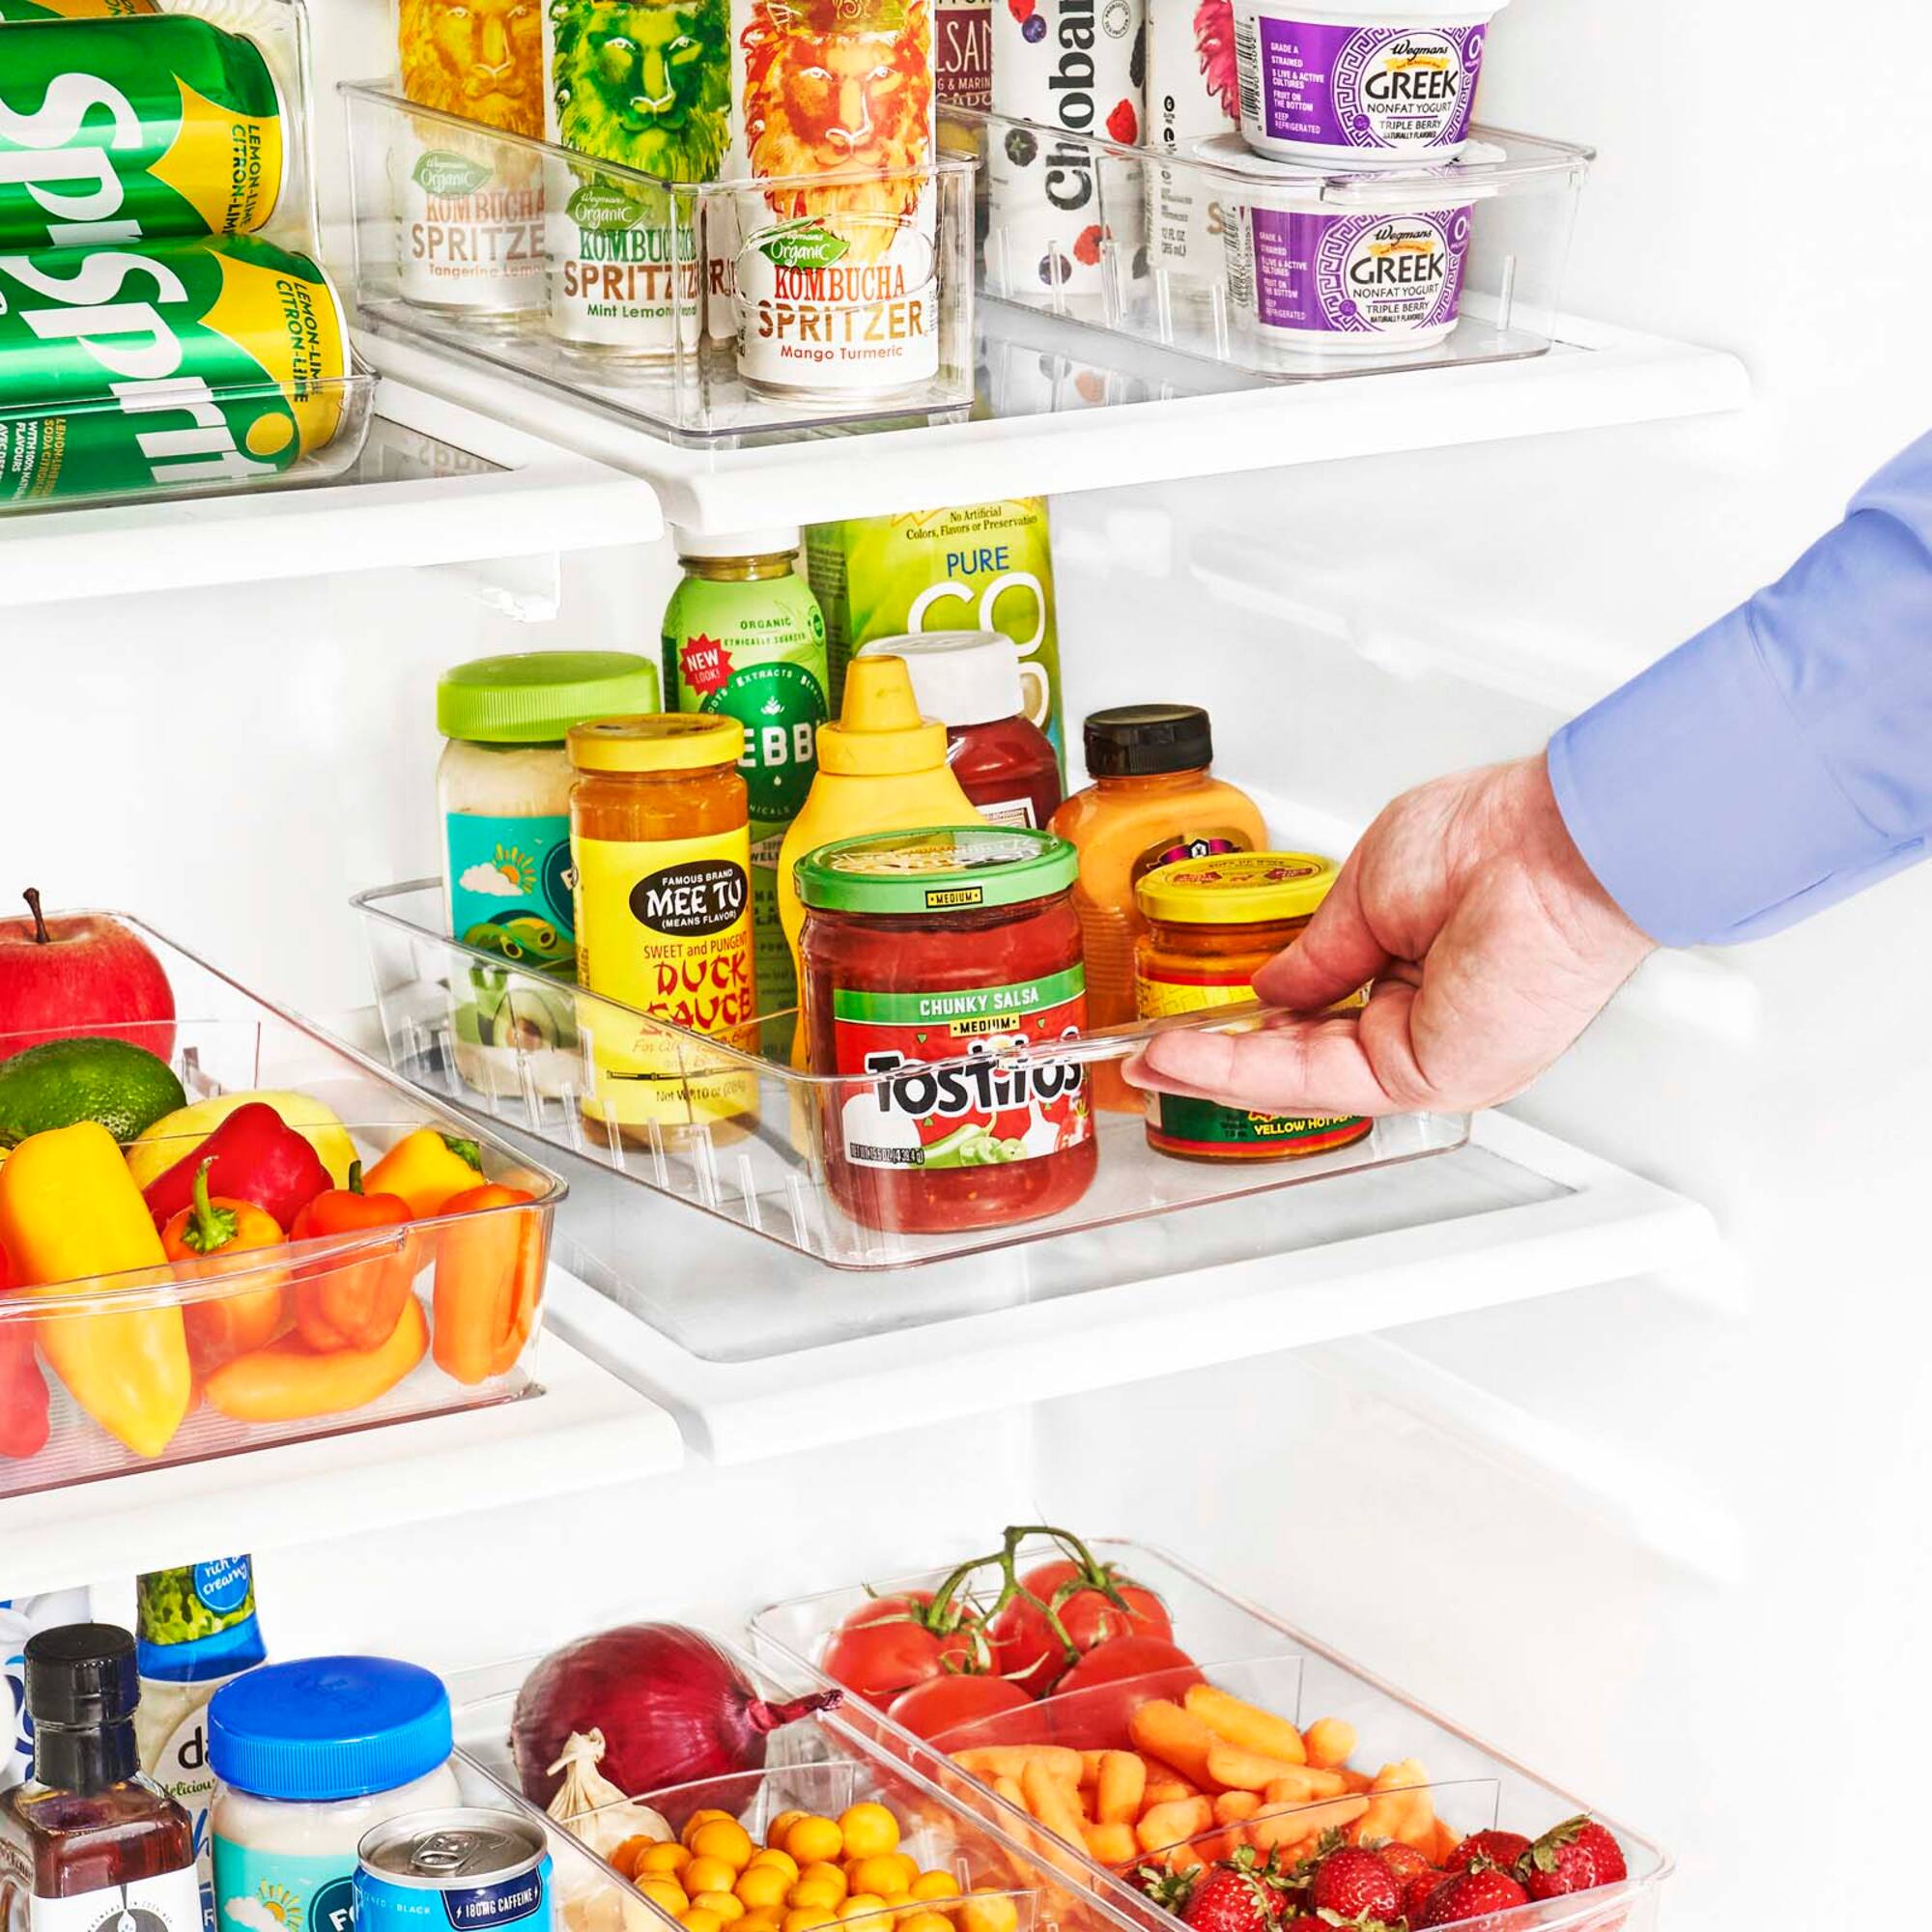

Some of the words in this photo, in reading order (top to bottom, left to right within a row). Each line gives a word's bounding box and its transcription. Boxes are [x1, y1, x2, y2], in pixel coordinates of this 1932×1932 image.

[1293, 45, 1299, 54] A
[1389, 40, 1449, 62] Wegmans
[1271, 55, 1303, 68] STRAINED
[1272, 77, 1305, 89] CULTURES
[1277, 69, 1291, 79] LIVE
[1299, 71, 1324, 83] ACTIVE
[1365, 71, 1459, 99] GREEK
[1273, 90, 1291, 99] FRUIT
[1292, 92, 1301, 101] ON
[1286, 100, 1314, 111] BOTTOM
[1367, 102, 1413, 114] NONFAT
[1415, 100, 1452, 113] YOGURT
[1275, 112, 1289, 121] KEEP
[1380, 121, 1413, 130] TRIPLE
[1415, 120, 1442, 130] BERRY
[1275, 120, 1321, 134] REFRIGERATED
[241, 124, 261, 227] LEMON-LIME
[575, 204, 632, 229] Organic
[1374, 224, 1433, 246] Wegmans
[771, 241, 831, 267] Organic
[429, 264, 499, 279] Tangerine
[1284, 261, 1308, 271] ACTIVE
[1350, 252, 1445, 284] GREEK
[774, 263, 905, 302] KOMBUCHA
[1352, 287, 1401, 298] NONFAT
[1403, 283, 1440, 296] YOGURT
[587, 303, 618, 318] Mint
[1366, 304, 1400, 314] TRIPLE
[1403, 301, 1430, 313] BERRY
[758, 298, 923, 342] SPRITZER
[1371, 315, 1400, 324] NATURALLY
[781, 345, 834, 362] Mango
[839, 345, 904, 360] Turmeric
[27, 421, 38, 450] WITH
[43, 418, 54, 449] SODA
[12, 422, 26, 471] FLAVOURS
[950, 510, 962, 523] No
[964, 506, 1002, 521] Artificial
[906, 528, 939, 540] Colors,
[941, 525, 970, 536] Flavors
[947, 546, 1009, 578] PURE
[740, 617, 792, 630] ORGANIC
[686, 649, 719, 672] NEW
[695, 668, 721, 685] LOOK!
[736, 668, 793, 688] EXTRACTS
[662, 873, 703, 887] FAMOUS
[705, 868, 733, 882] BRAND
[646, 885, 707, 918] MEE
[713, 878, 743, 910] TU
[936, 892, 974, 904] MEDIUM
[662, 916, 700, 929] (MEANS
[703, 910, 737, 924] FLAVOR)
[643, 943, 683, 960] SWEET
[687, 941, 707, 957] and
[710, 931, 749, 953] PUNGENT
[653, 952, 748, 996] DUCK
[920, 995, 988, 1017] CHUNKY
[993, 985, 1039, 1009] SALSA
[639, 987, 753, 1037] SAUCE
[959, 1017, 1010, 1035] MEDIUM
[1255, 1121, 1305, 1135] YELLOW
[1308, 1115, 1329, 1129] HOT
[204, 1558, 231, 1577] rich
[203, 1562, 246, 1595] creamy
[396, 1903, 431, 1915] BLACK
[465, 1900, 497, 1918] 180MG
[498, 1889, 533, 1913] CAFFEINE
